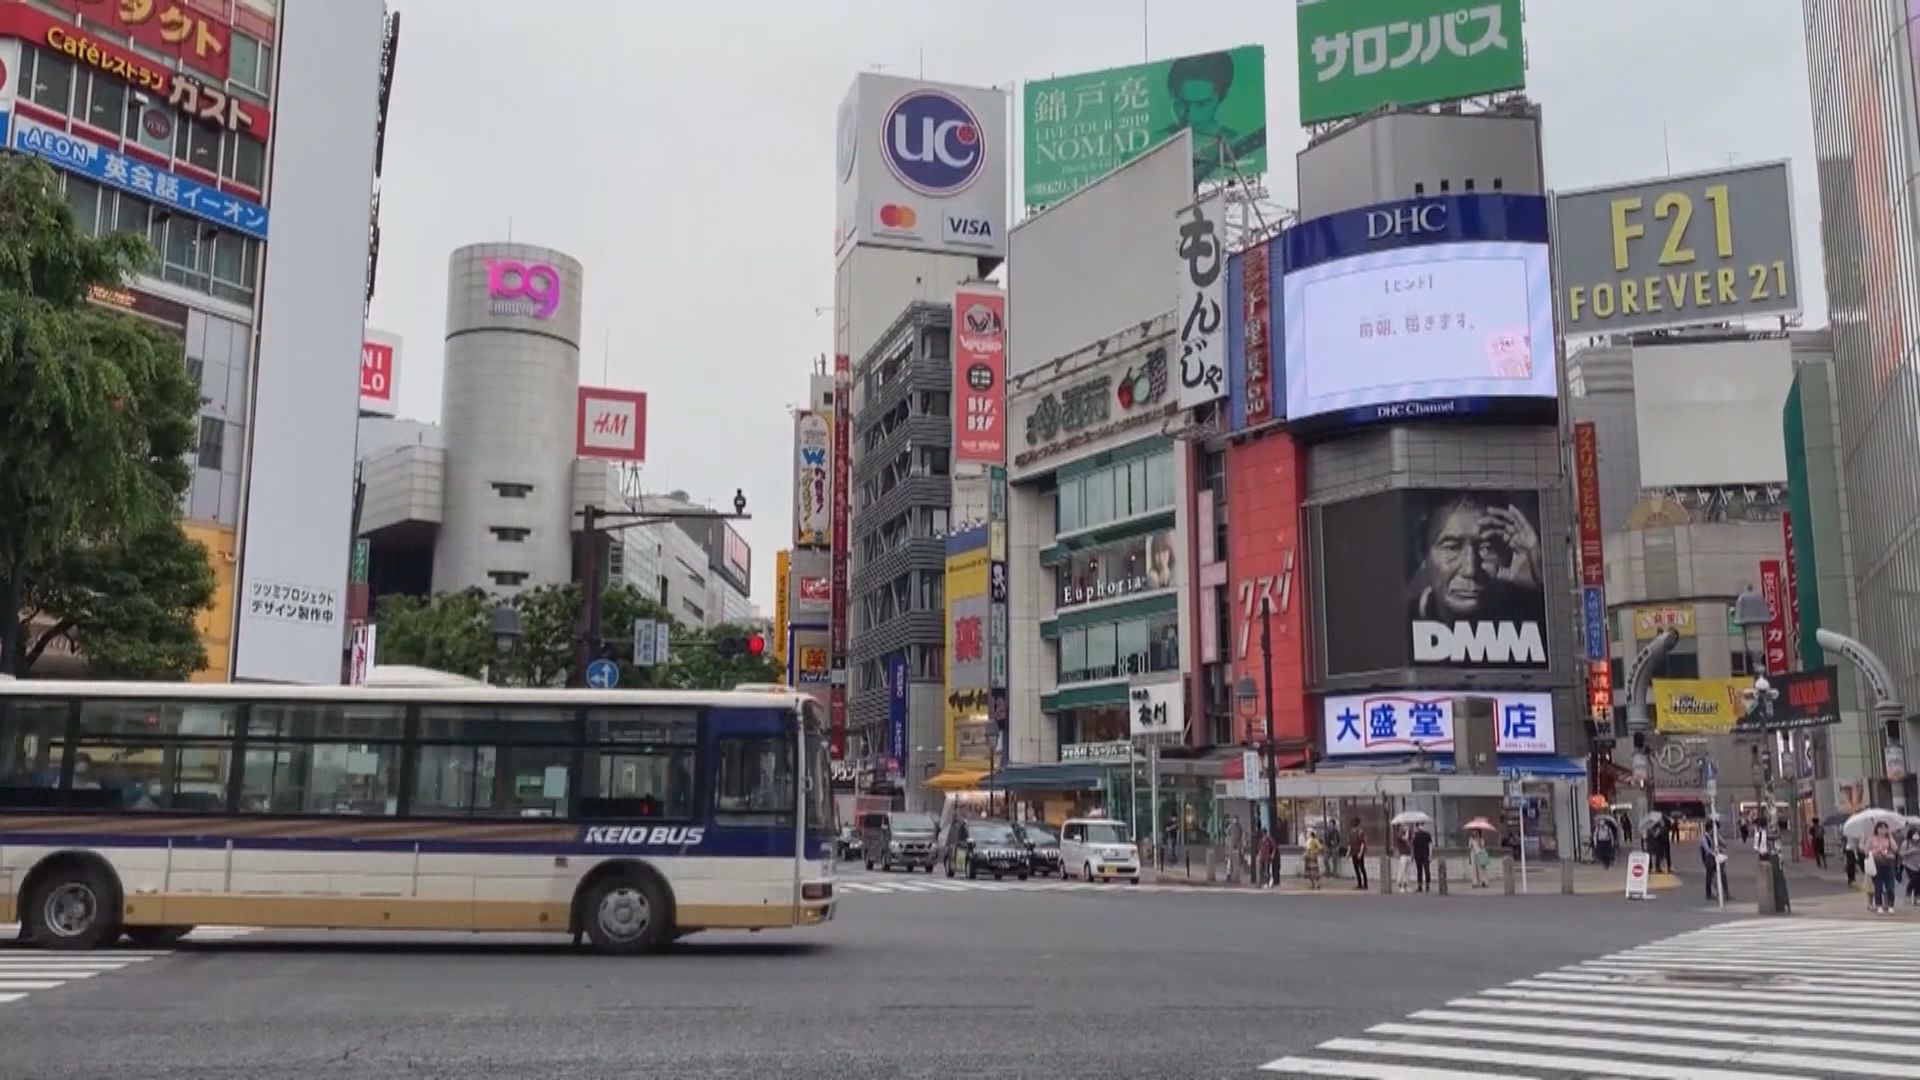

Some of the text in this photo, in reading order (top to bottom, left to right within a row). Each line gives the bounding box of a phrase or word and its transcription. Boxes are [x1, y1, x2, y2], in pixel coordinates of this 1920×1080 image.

[1311, 4, 1508, 82] サロンパス
[169, 75, 254, 132] ガスト
[1034, 76, 1149, 124] 錦戸亮
[1119, 113, 1149, 129] 2019
[26, 128, 89, 164] AEON
[1037, 129, 1149, 165] NOMAD
[103, 155, 265, 230] 英会話イーオン
[949, 217, 992, 237] VISA
[1366, 204, 1447, 239] DHC
[1610, 184, 1734, 272] F21
[485, 256, 561, 320] 109
[1178, 200, 1223, 394] もんじゃ
[1570, 259, 1788, 321] FOREVER 21
[592, 412, 628, 437] H&M
[1377, 401, 1455, 419] DHC Channel
[253, 582, 335, 607] ツツミプロジェクト
[1064, 574, 1142, 604] Euphoria
[252, 600, 334, 624] デザイン製作中
[1412, 620, 1547, 663] DMM
[1767, 629, 1787, 674] カラ
[1336, 703, 1538, 740] 大盛堂店
[584, 826, 706, 846] KEIO BUS
